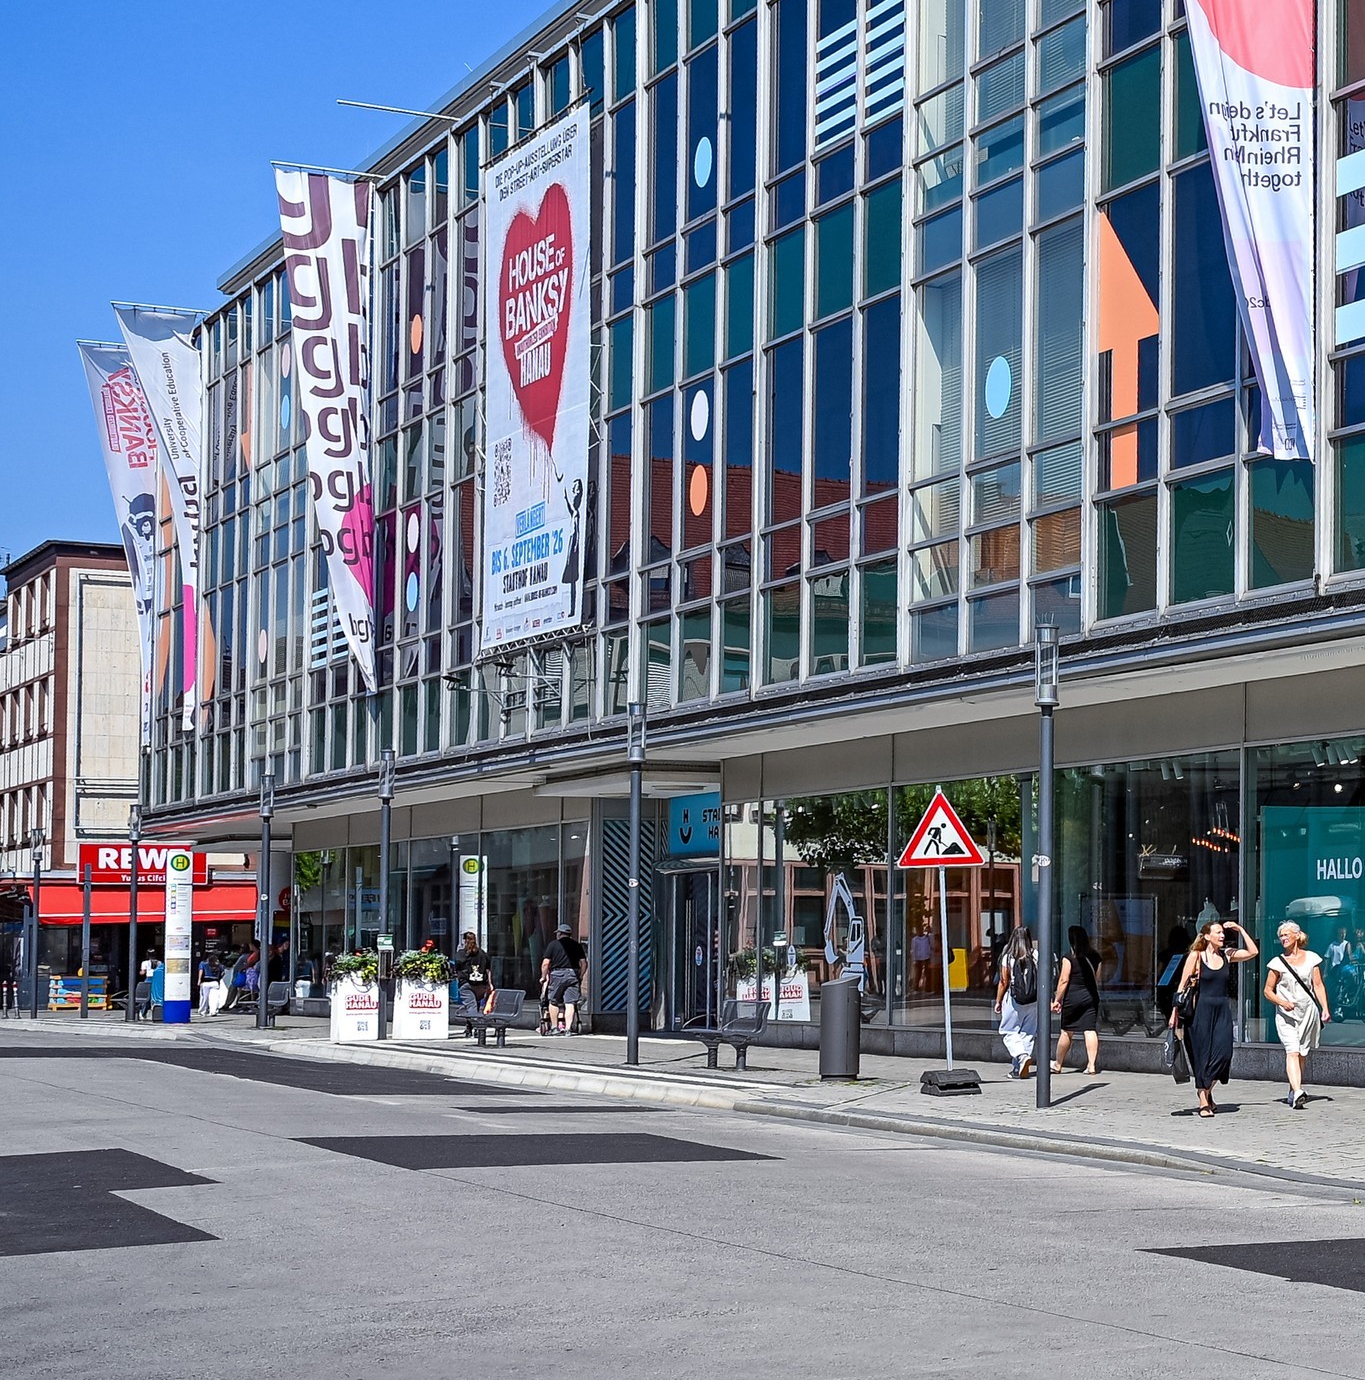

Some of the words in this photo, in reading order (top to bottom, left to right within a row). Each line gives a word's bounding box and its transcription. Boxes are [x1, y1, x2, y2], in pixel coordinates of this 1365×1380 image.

[508, 233, 555, 293] HOUSE
[555, 247, 566, 266] OF
[505, 267, 569, 341] BANKSY
[161, 351, 177, 395] Education
[520, 341, 551, 389] HANAU
[171, 391, 189, 448] Cooperative
[162, 417, 180, 460] University
[511, 532, 550, 569] SEPTEMBER
[98, 847, 169, 869] REW
[1316, 856, 1363, 880] HALLO
[345, 994, 371, 1002] GUDE
[346, 1001, 379, 1010] HANAU
[409, 993, 435, 1001] GUDE
[409, 1000, 442, 1008] HANAU
